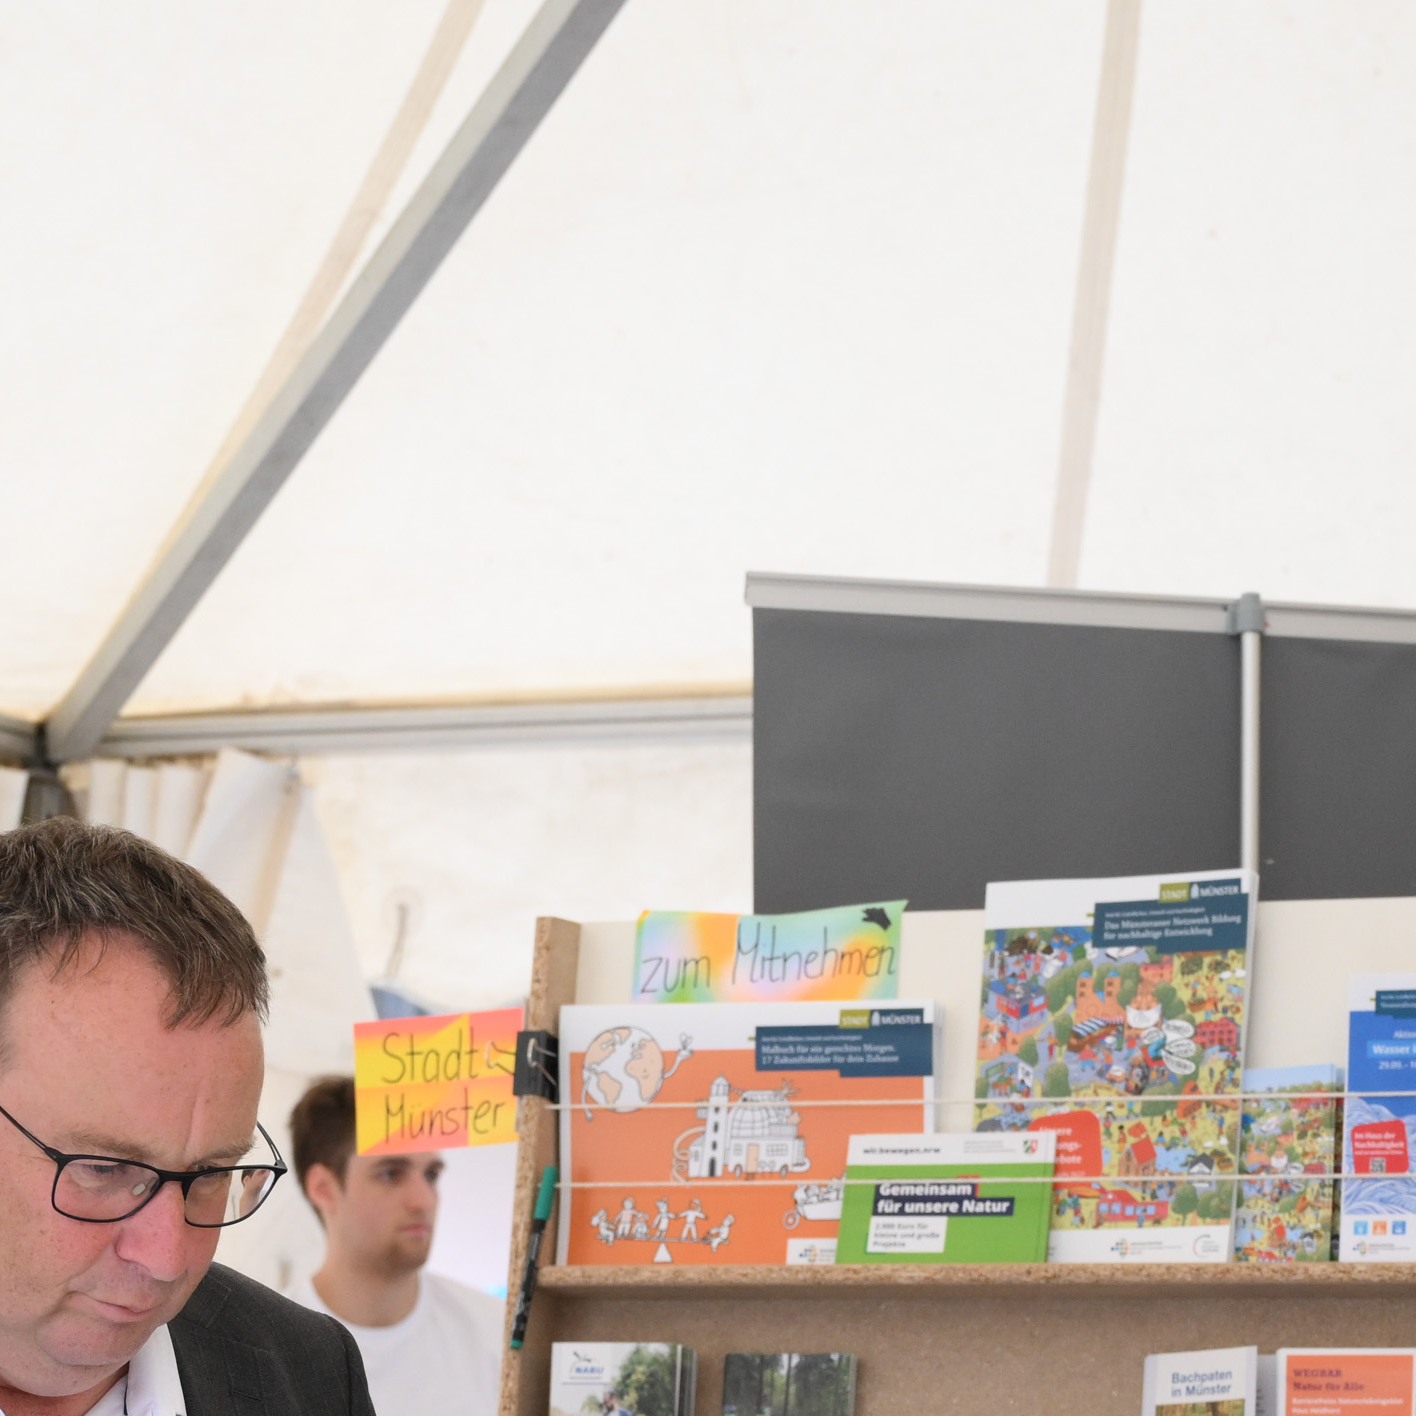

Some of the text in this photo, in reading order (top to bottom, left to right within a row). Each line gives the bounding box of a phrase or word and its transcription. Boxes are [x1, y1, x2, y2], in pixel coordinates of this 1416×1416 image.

[1211, 913, 1242, 925] Bildung
[639, 921, 897, 994] zum Mitnehmen
[381, 1026, 480, 1084] Stadt
[1371, 1044, 1411, 1055] Wasser
[384, 1086, 507, 1145] Münster
[878, 1182, 973, 1197] Gemeinsam
[876, 1199, 1011, 1215] für unsere Natur
[1171, 1368, 1233, 1385] Bachpaten
[1171, 1382, 1233, 1398] in Münster
[1324, 1382, 1341, 1392] für
